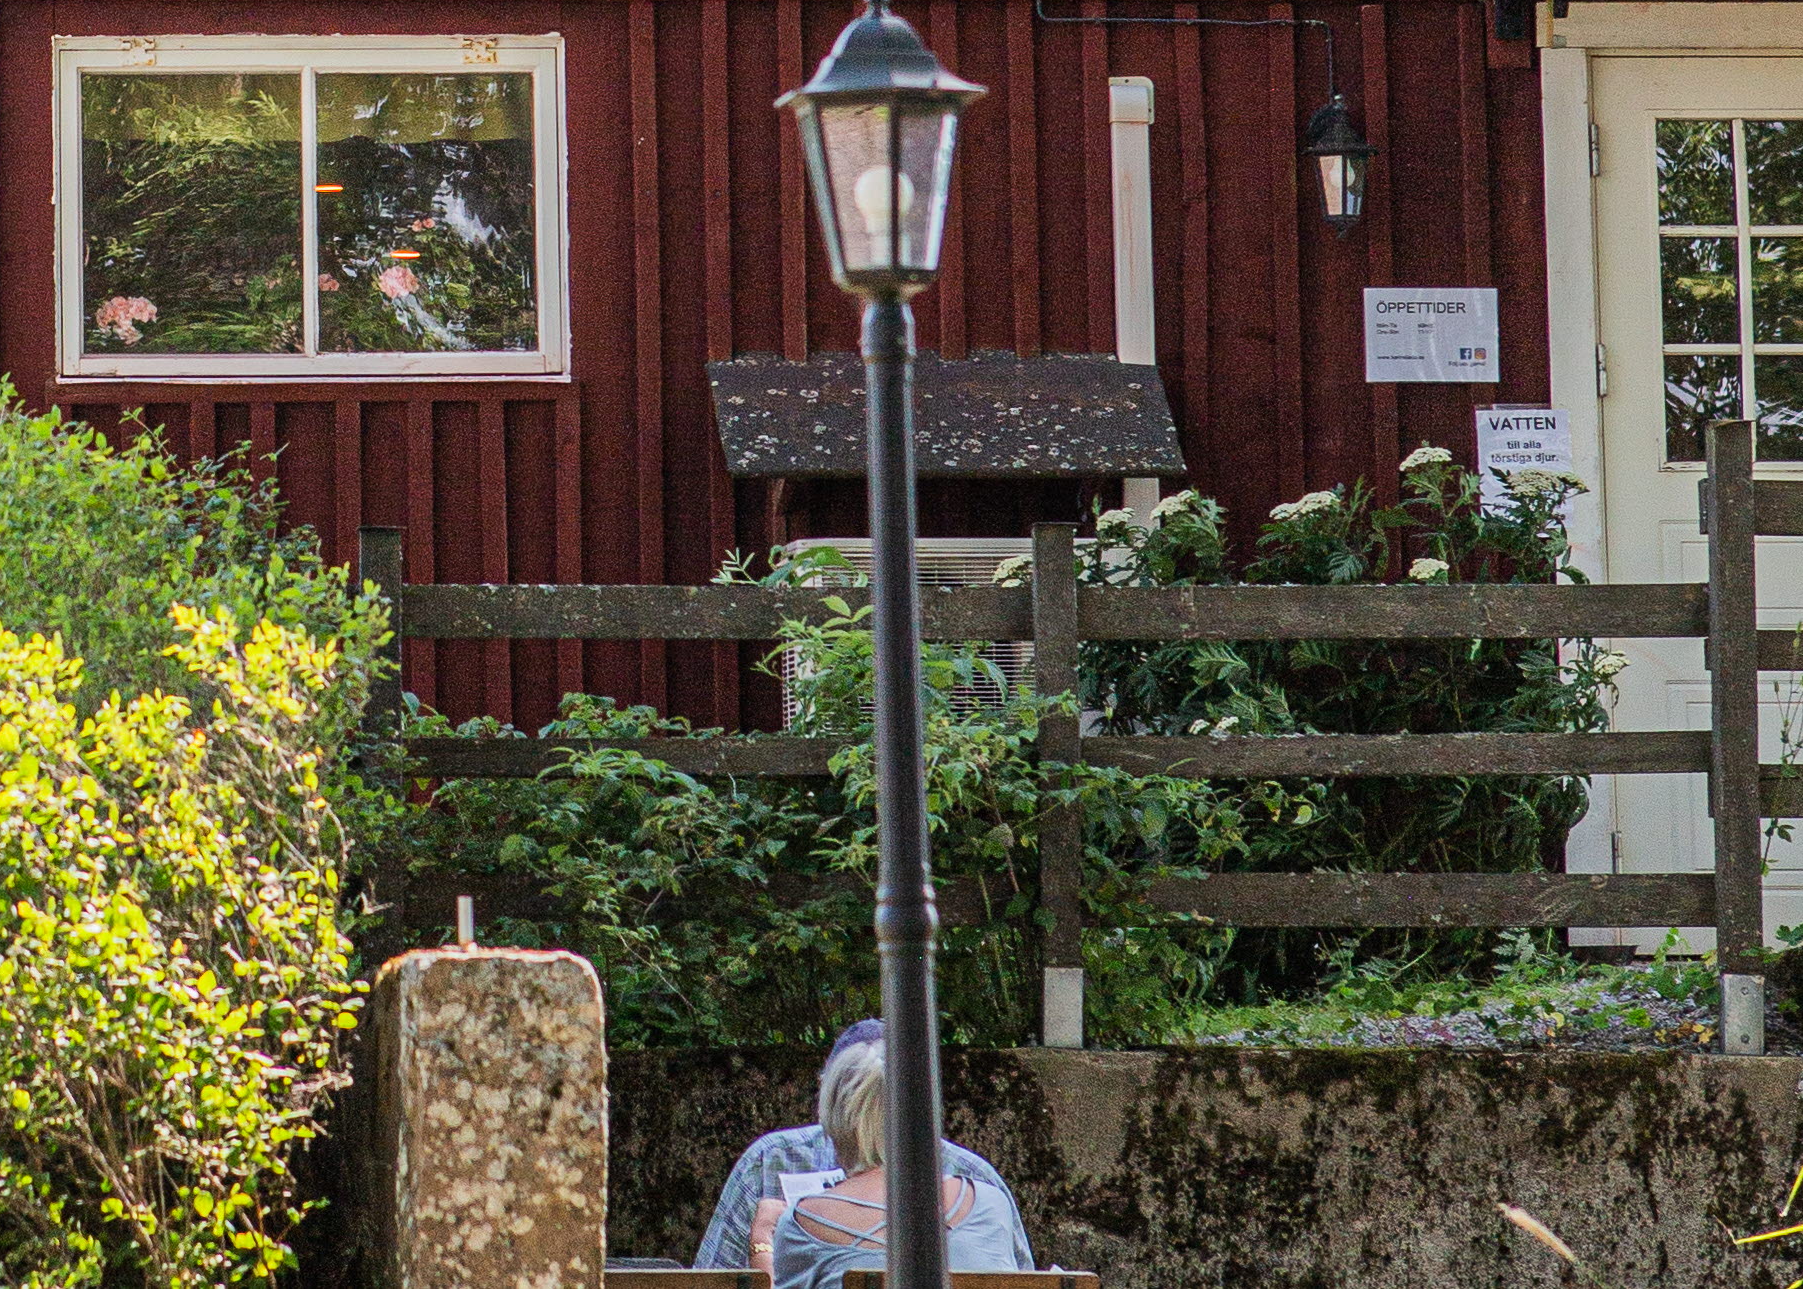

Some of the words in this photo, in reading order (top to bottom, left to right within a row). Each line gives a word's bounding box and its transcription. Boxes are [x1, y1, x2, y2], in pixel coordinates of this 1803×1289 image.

[1376, 300, 1466, 314] ÖPPETTIDER
[1489, 417, 1556, 430] VATTEN
[1507, 441, 1520, 449] till
[1523, 441, 1542, 449] alla
